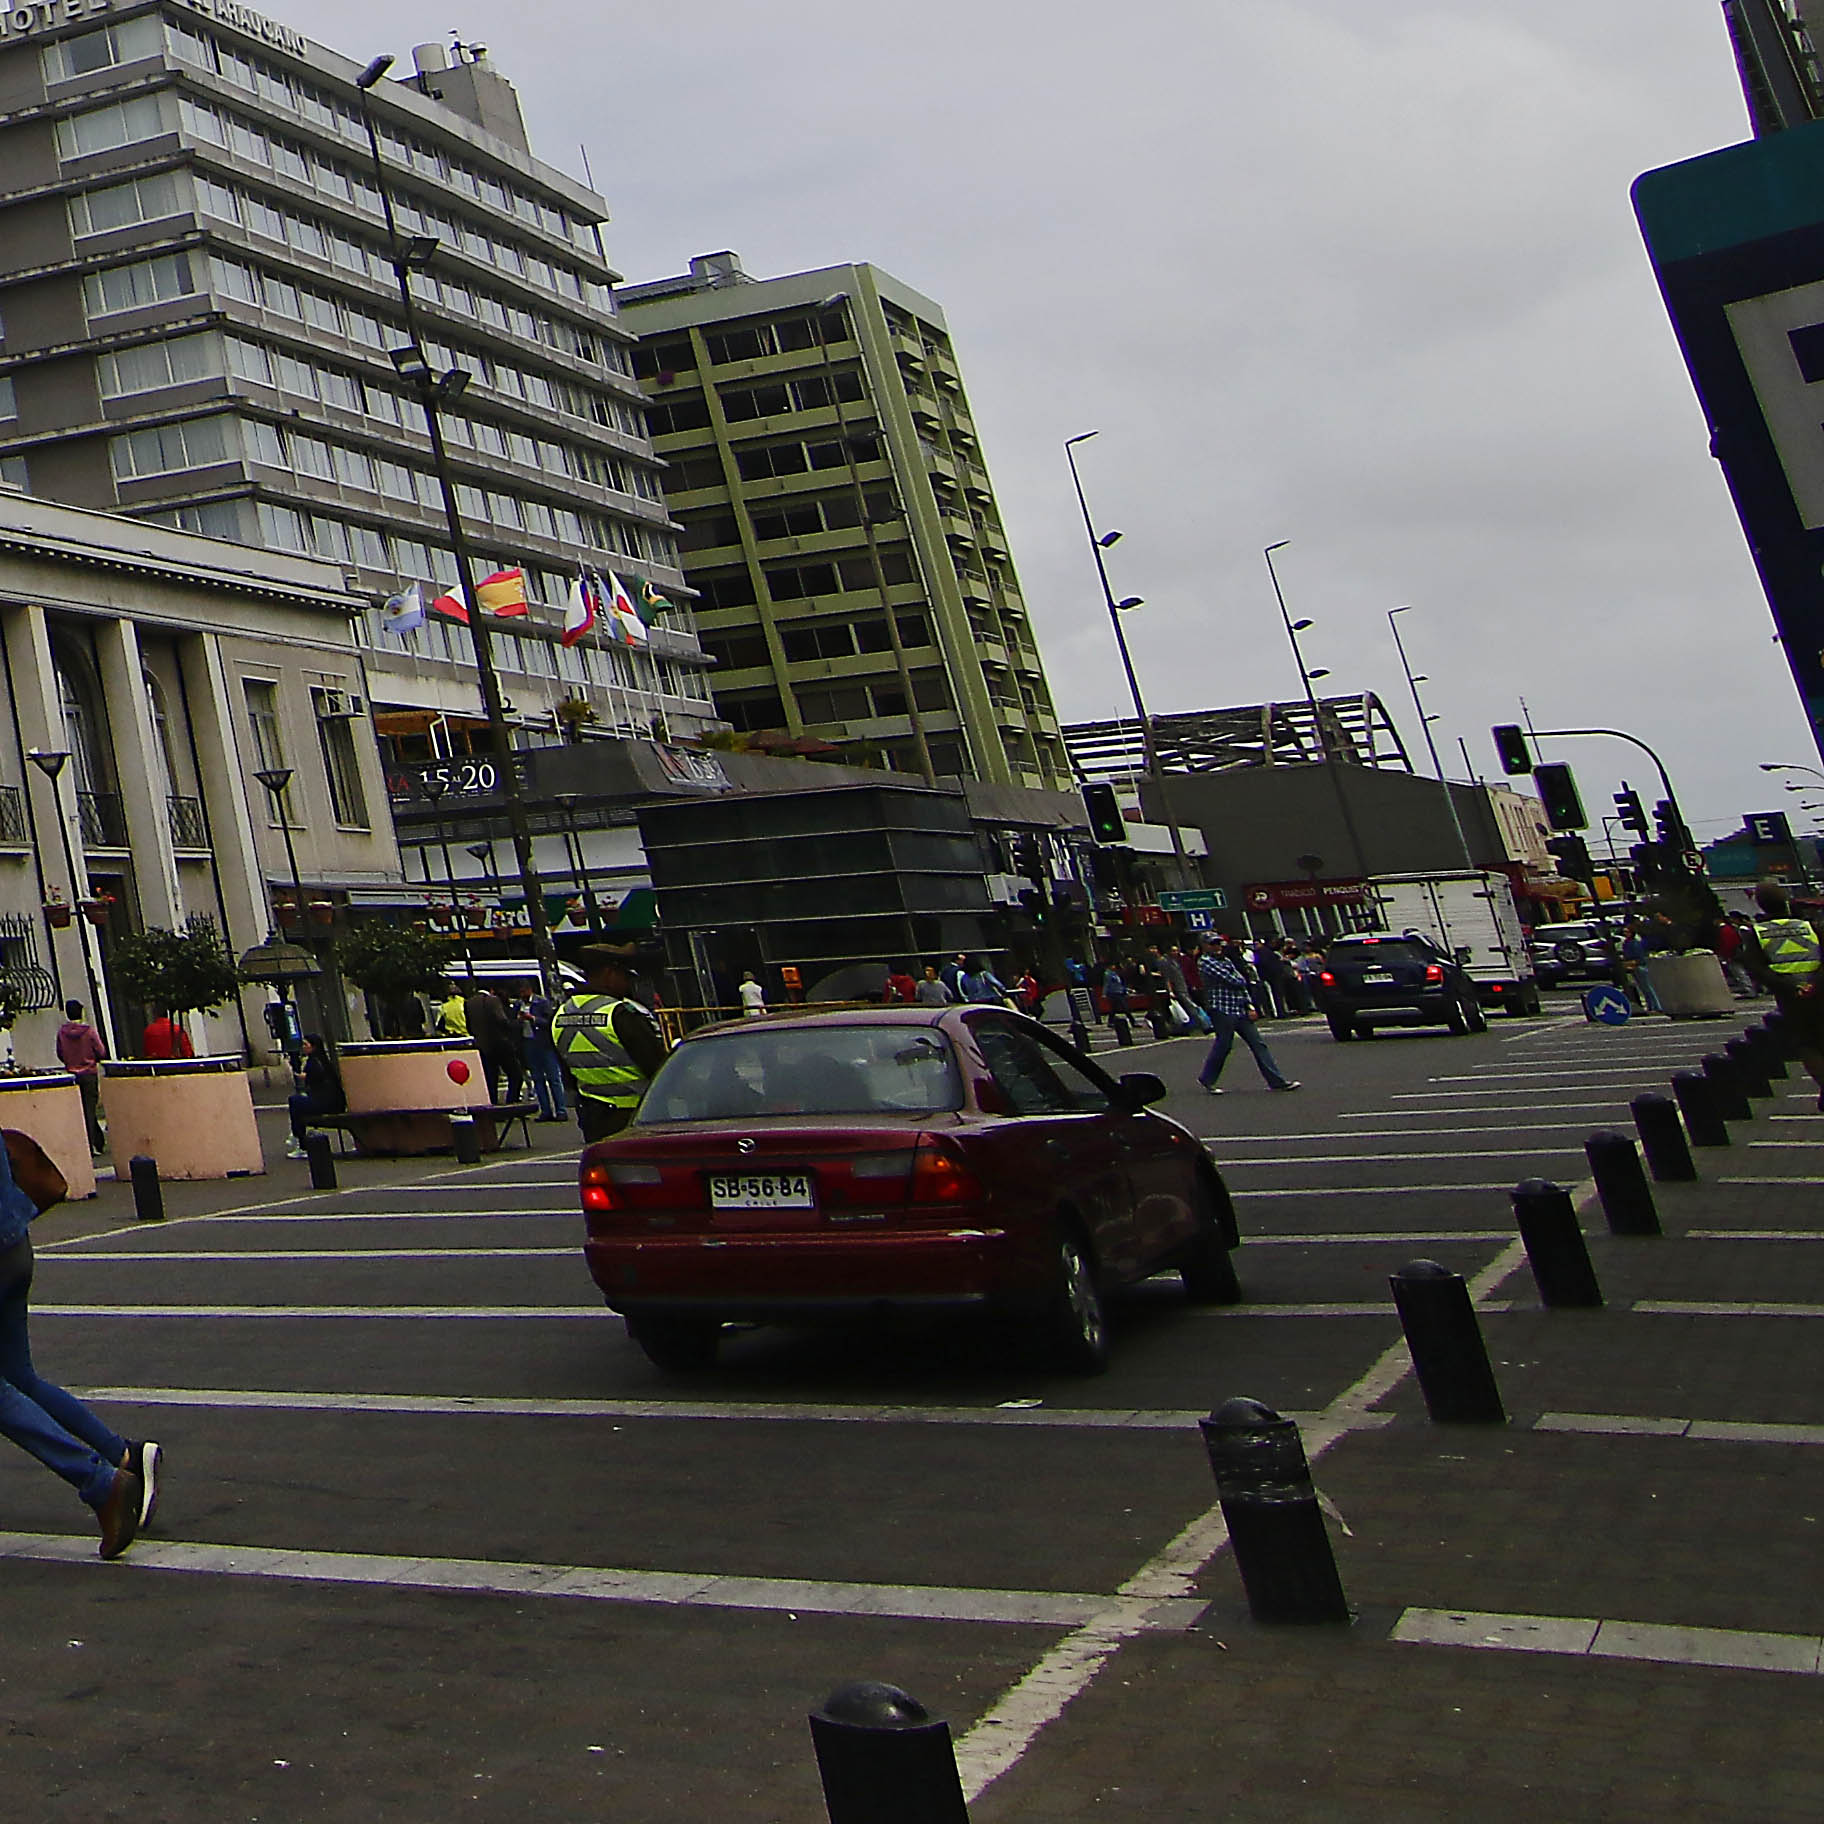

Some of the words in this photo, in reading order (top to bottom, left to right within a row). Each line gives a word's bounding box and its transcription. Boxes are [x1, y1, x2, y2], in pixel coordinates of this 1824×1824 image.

[461, 763, 496, 791] 20
[1753, 819, 1775, 840] E
[1190, 913, 1205, 927] H
